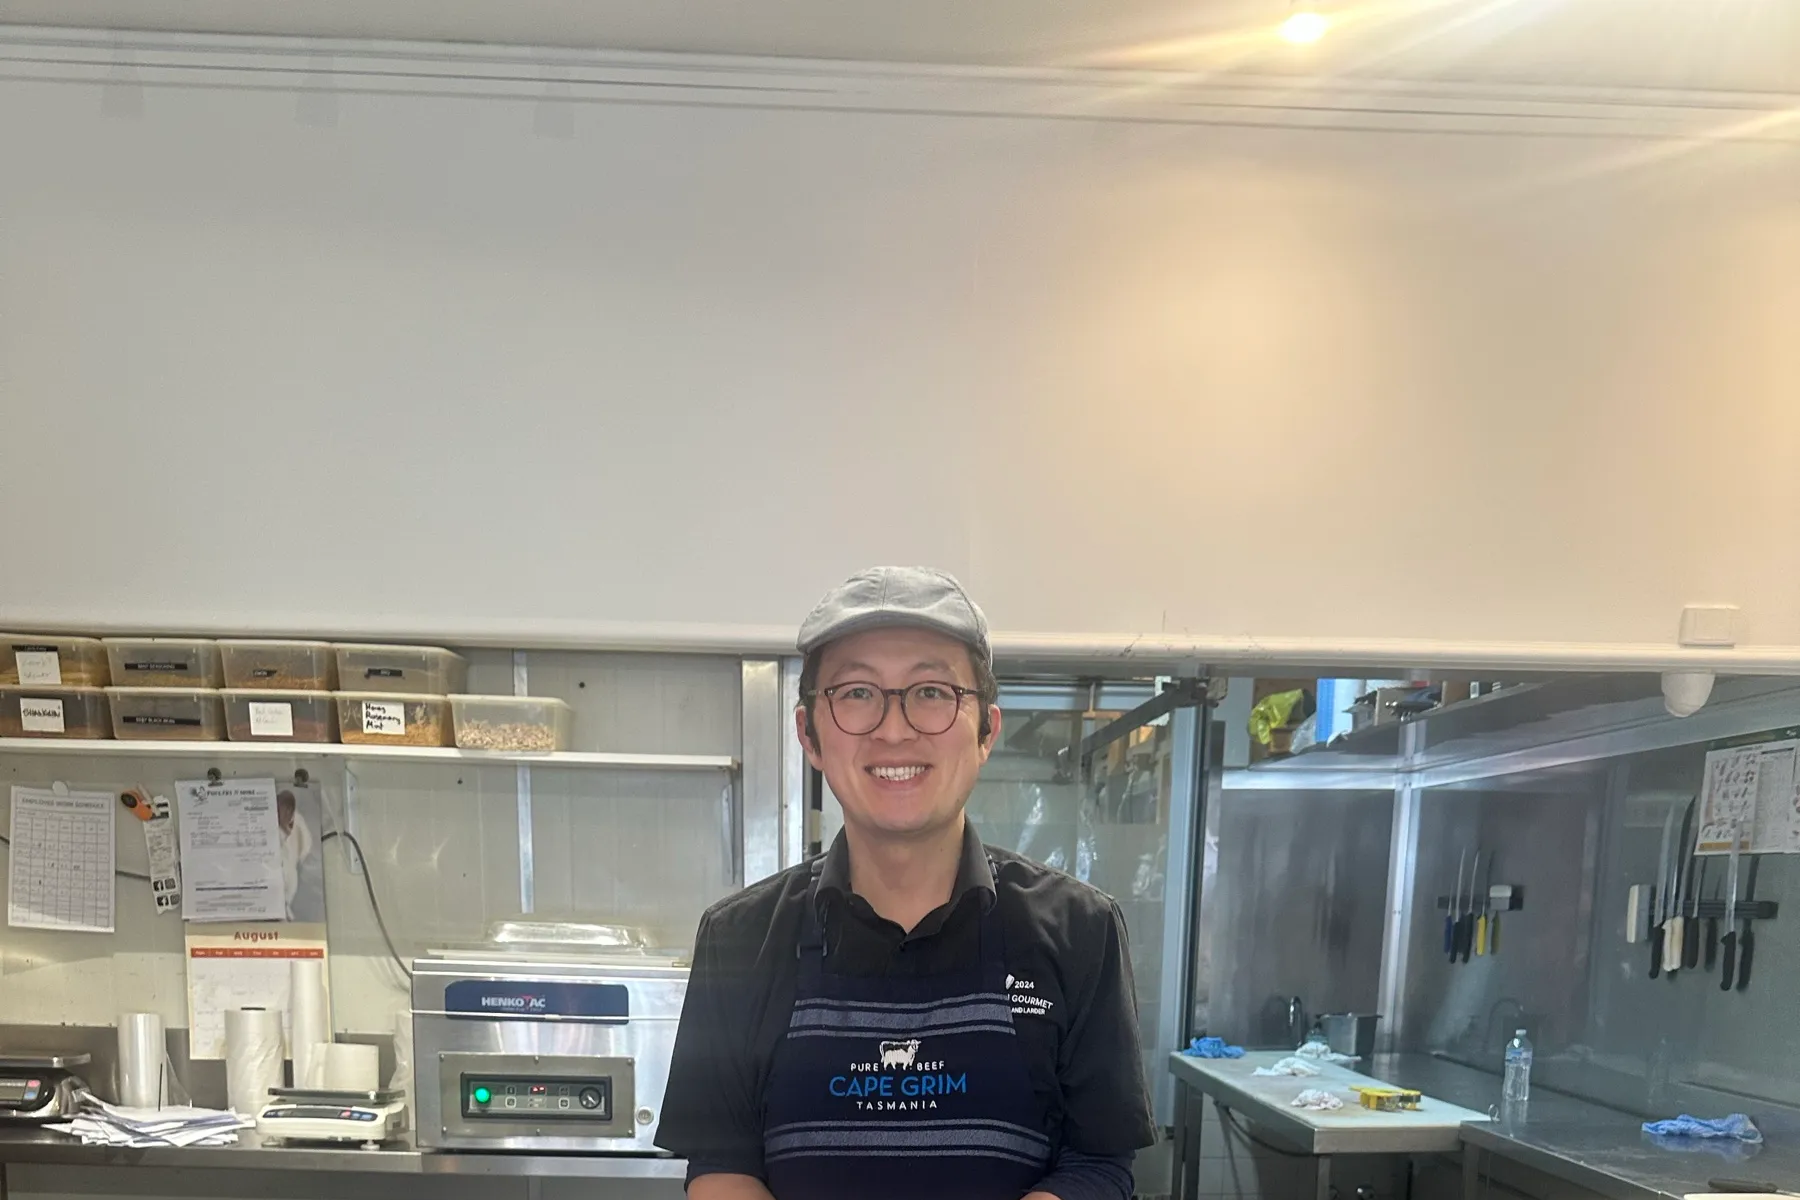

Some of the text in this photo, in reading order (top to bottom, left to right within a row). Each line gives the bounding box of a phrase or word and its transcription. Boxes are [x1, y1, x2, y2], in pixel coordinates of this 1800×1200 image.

[234, 931, 279, 942] August
[1014, 980, 1035, 989] 2024
[1011, 994, 1054, 1010] GOURMET
[1011, 1006, 1046, 1015] AND LARDER
[850, 1060, 945, 1072] PURE BEEF
[828, 1072, 967, 1097] CAPE GRIM
[856, 1099, 938, 1111] TASMANIA
